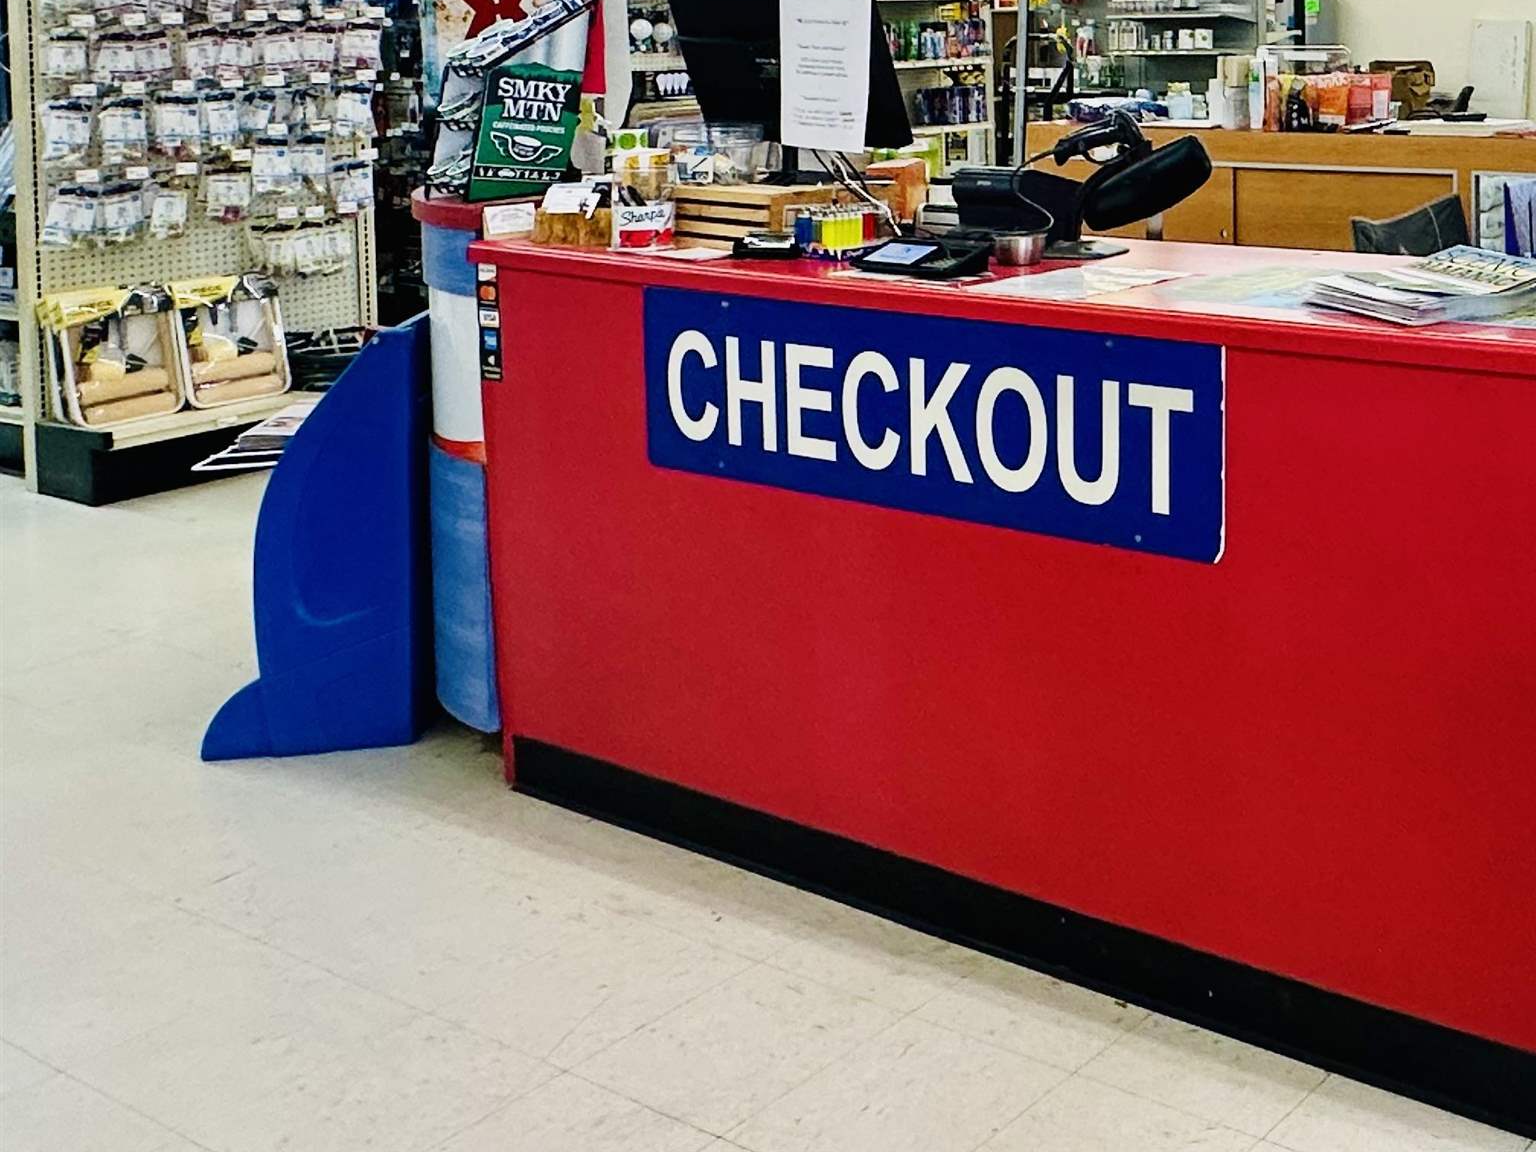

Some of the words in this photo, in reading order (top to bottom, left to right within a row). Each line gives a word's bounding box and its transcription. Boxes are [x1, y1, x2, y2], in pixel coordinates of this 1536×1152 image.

[498, 77, 572, 102] SMKY
[502, 98, 563, 121] MTN
[667, 329, 1194, 516] CHECKOUT
